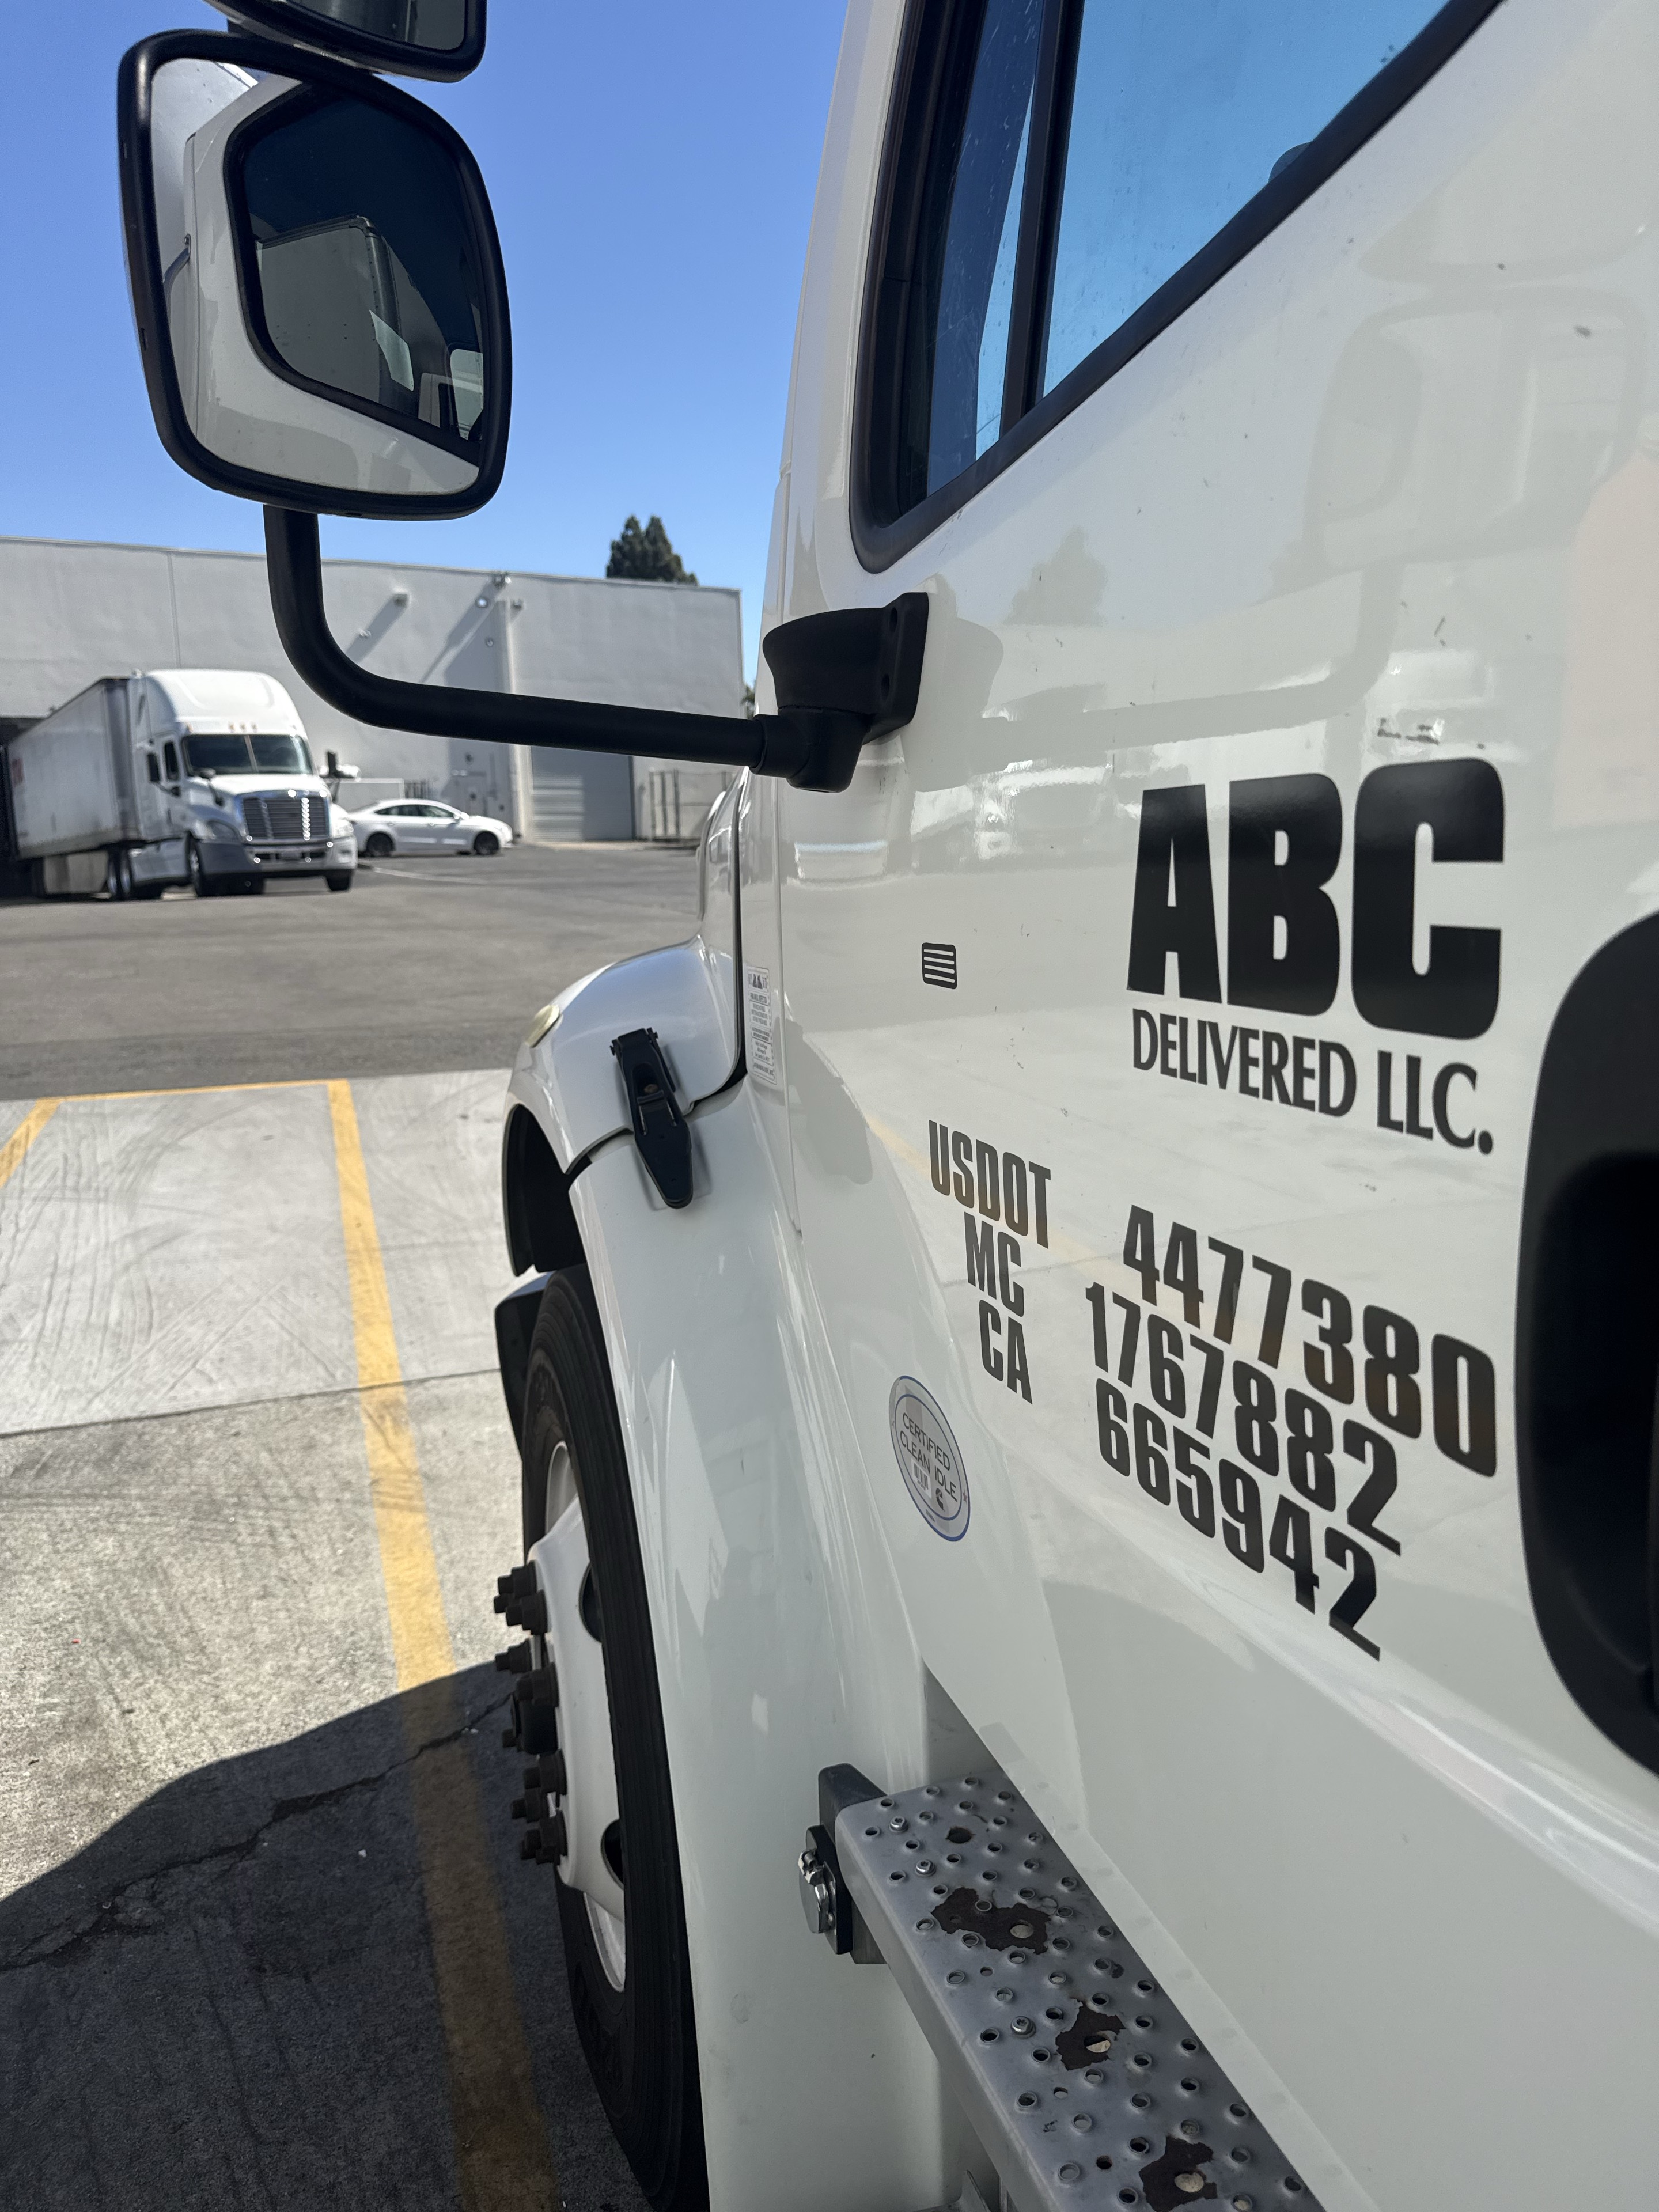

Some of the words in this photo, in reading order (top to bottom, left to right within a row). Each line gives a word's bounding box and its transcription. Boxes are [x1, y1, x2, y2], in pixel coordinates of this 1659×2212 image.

[1126, 757, 1505, 1041] ABC
[1132, 1008, 1357, 1118] DELIVERED
[1377, 1050, 1493, 1155] LLC.
[929, 1119, 1052, 1249] USDOT
[1123, 1204, 1498, 1478] 4477380
[964, 1211, 1025, 1318] MC
[1085, 1281, 1402, 1557] 1767882
[900, 1430, 930, 1472] CLEAN
[934, 1465, 957, 1502] IDLE
[903, 1412, 950, 1471] CERTIFIED
[979, 1299, 1033, 1406] CA
[1096, 1377, 1381, 1662] 665942
